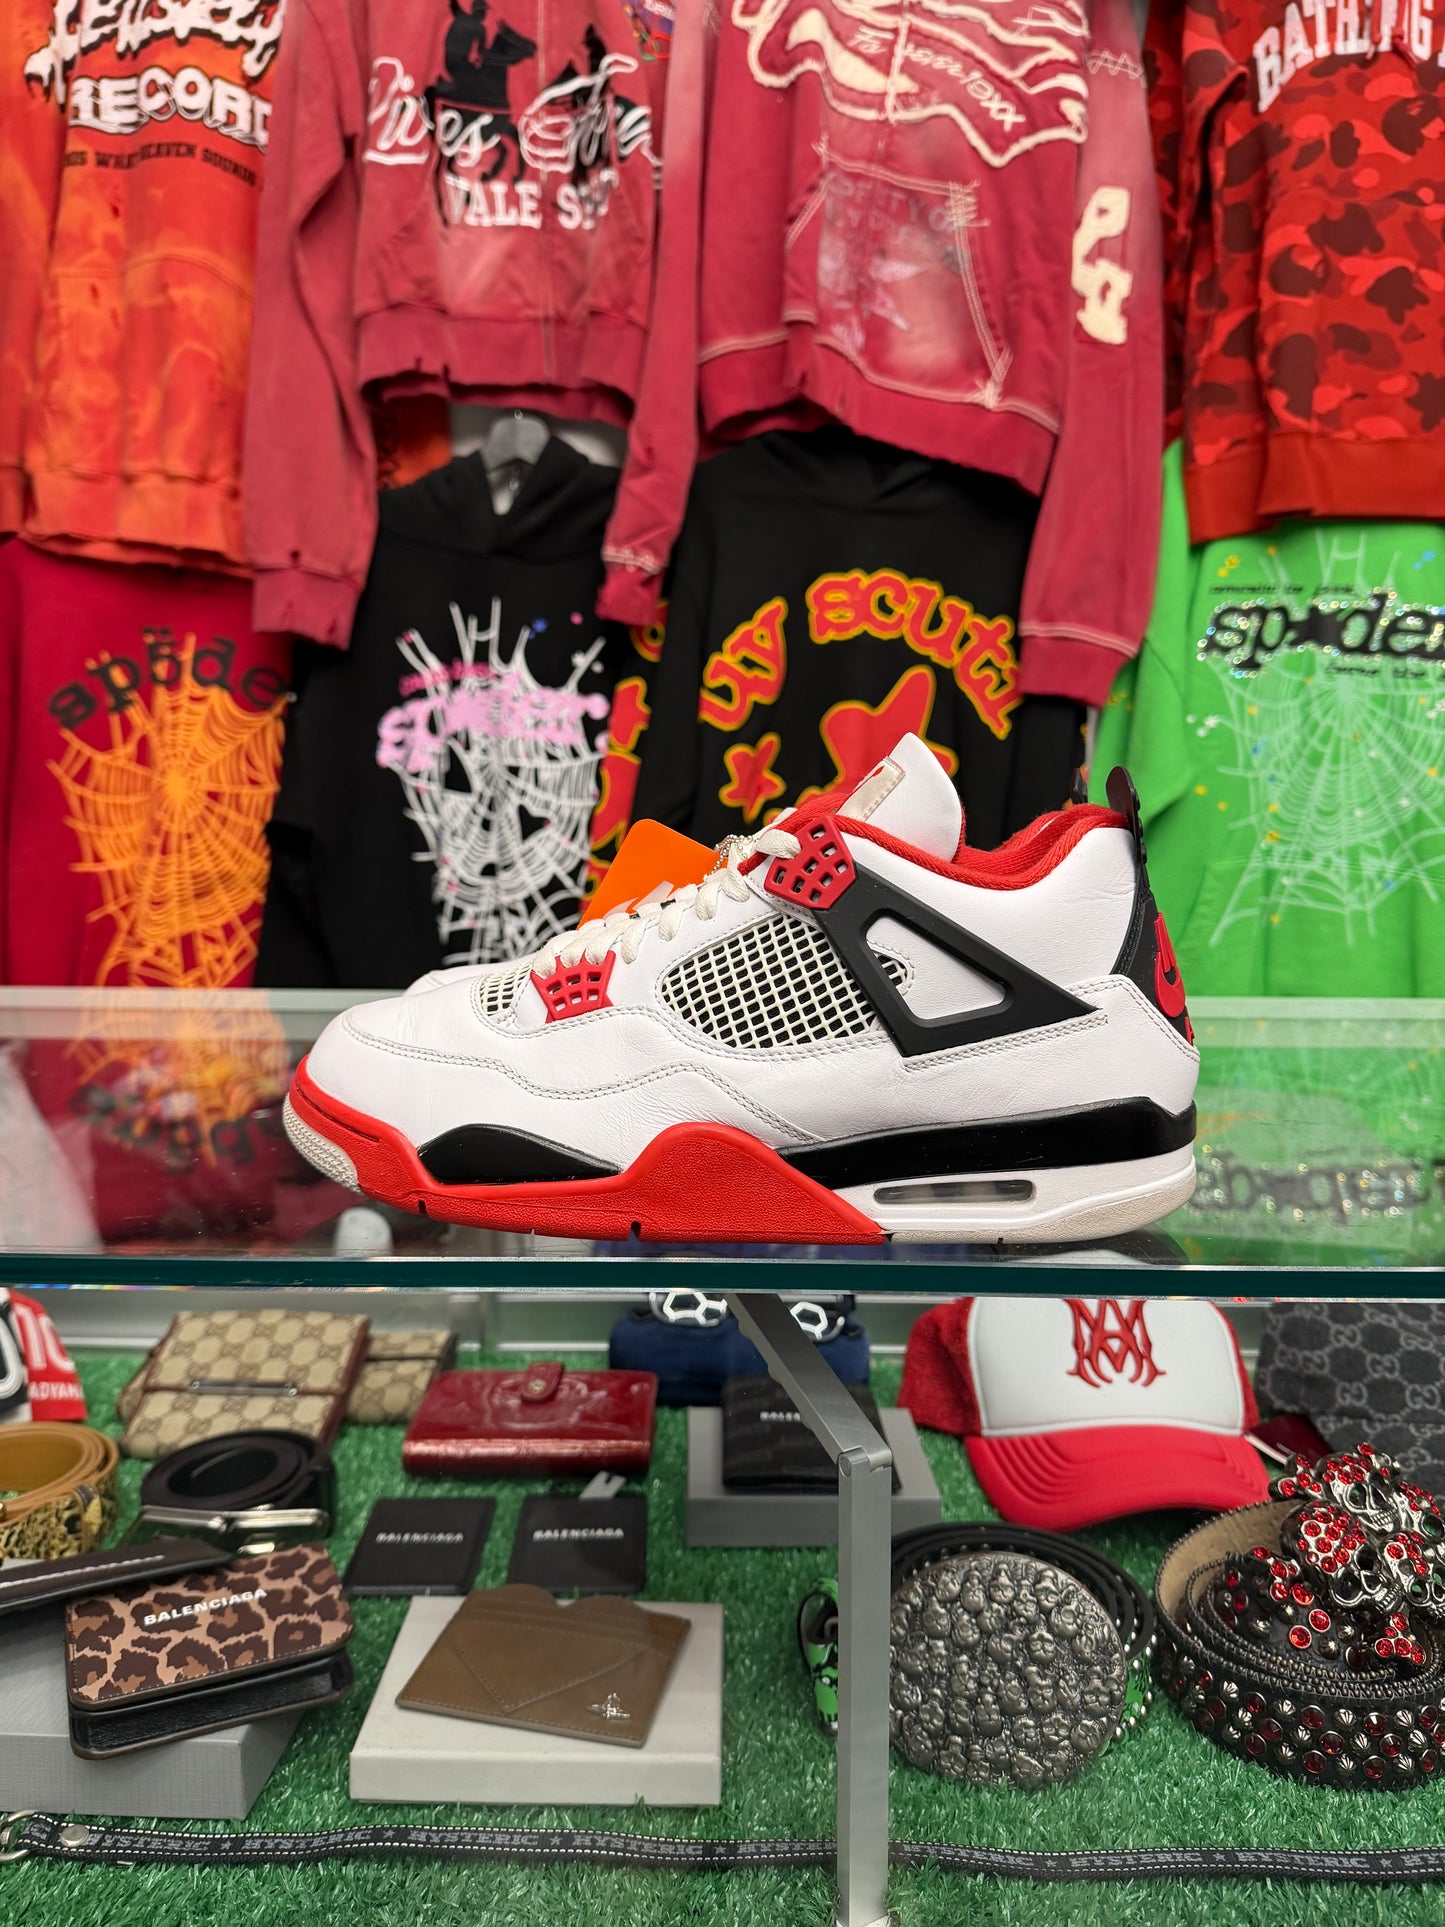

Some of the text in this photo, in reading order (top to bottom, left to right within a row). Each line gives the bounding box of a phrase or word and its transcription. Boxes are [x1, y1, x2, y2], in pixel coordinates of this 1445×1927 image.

[143, 1588, 267, 1626] BALENCIAGA
[242, 1829, 372, 1850] HYSTERIC
[408, 1829, 539, 1846] HYSTERIC
[572, 1834, 703, 1855] HYSTERIC
[903, 1843, 1034, 1866] HYSTERIC
[1069, 1852, 1202, 1867] HYSTERIC
[1234, 1851, 1370, 1868] HYSTERIC
